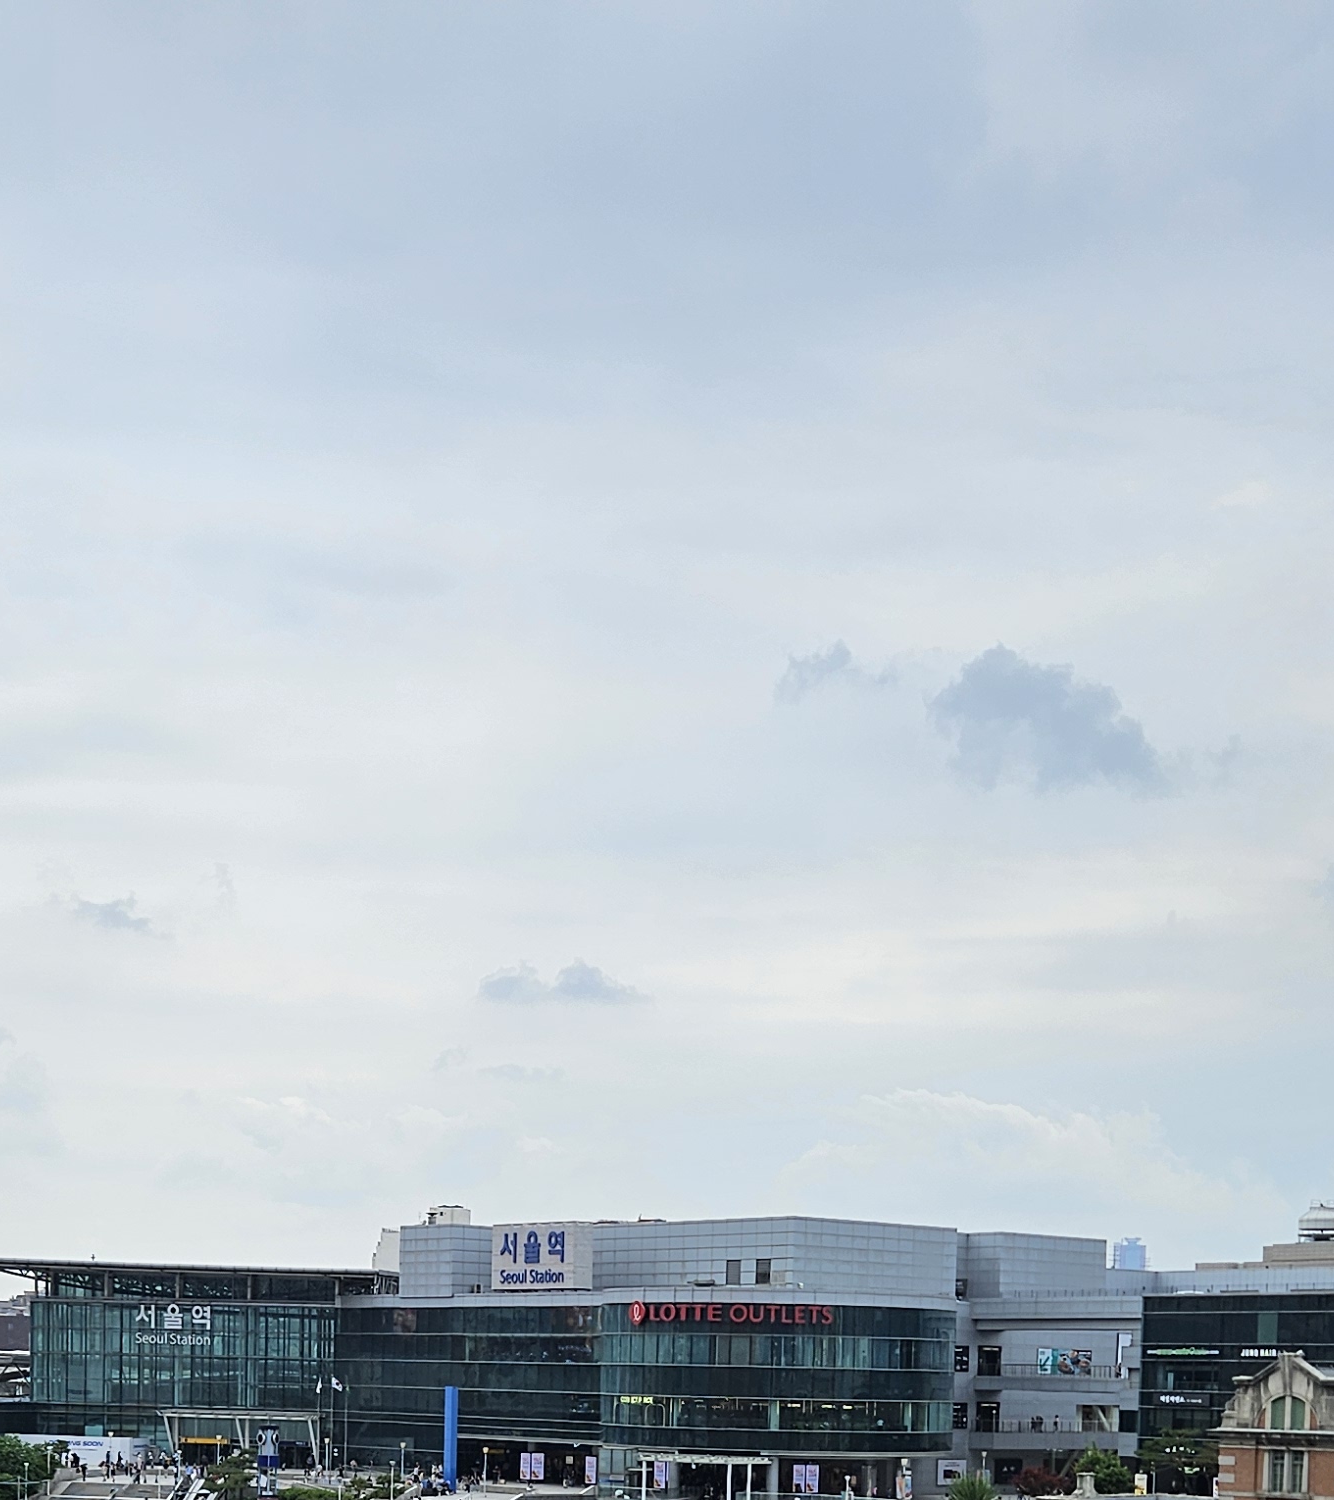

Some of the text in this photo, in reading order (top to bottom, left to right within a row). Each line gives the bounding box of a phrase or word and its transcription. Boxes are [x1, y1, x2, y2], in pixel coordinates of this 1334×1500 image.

[500, 1230, 565, 1264] 서울역
[500, 1268, 565, 1284] Seoul Station
[135, 1303, 211, 1330] 서울역
[649, 1302, 834, 1326] LOTTE OUTLETS
[135, 1332, 211, 1346] Seoul Station
